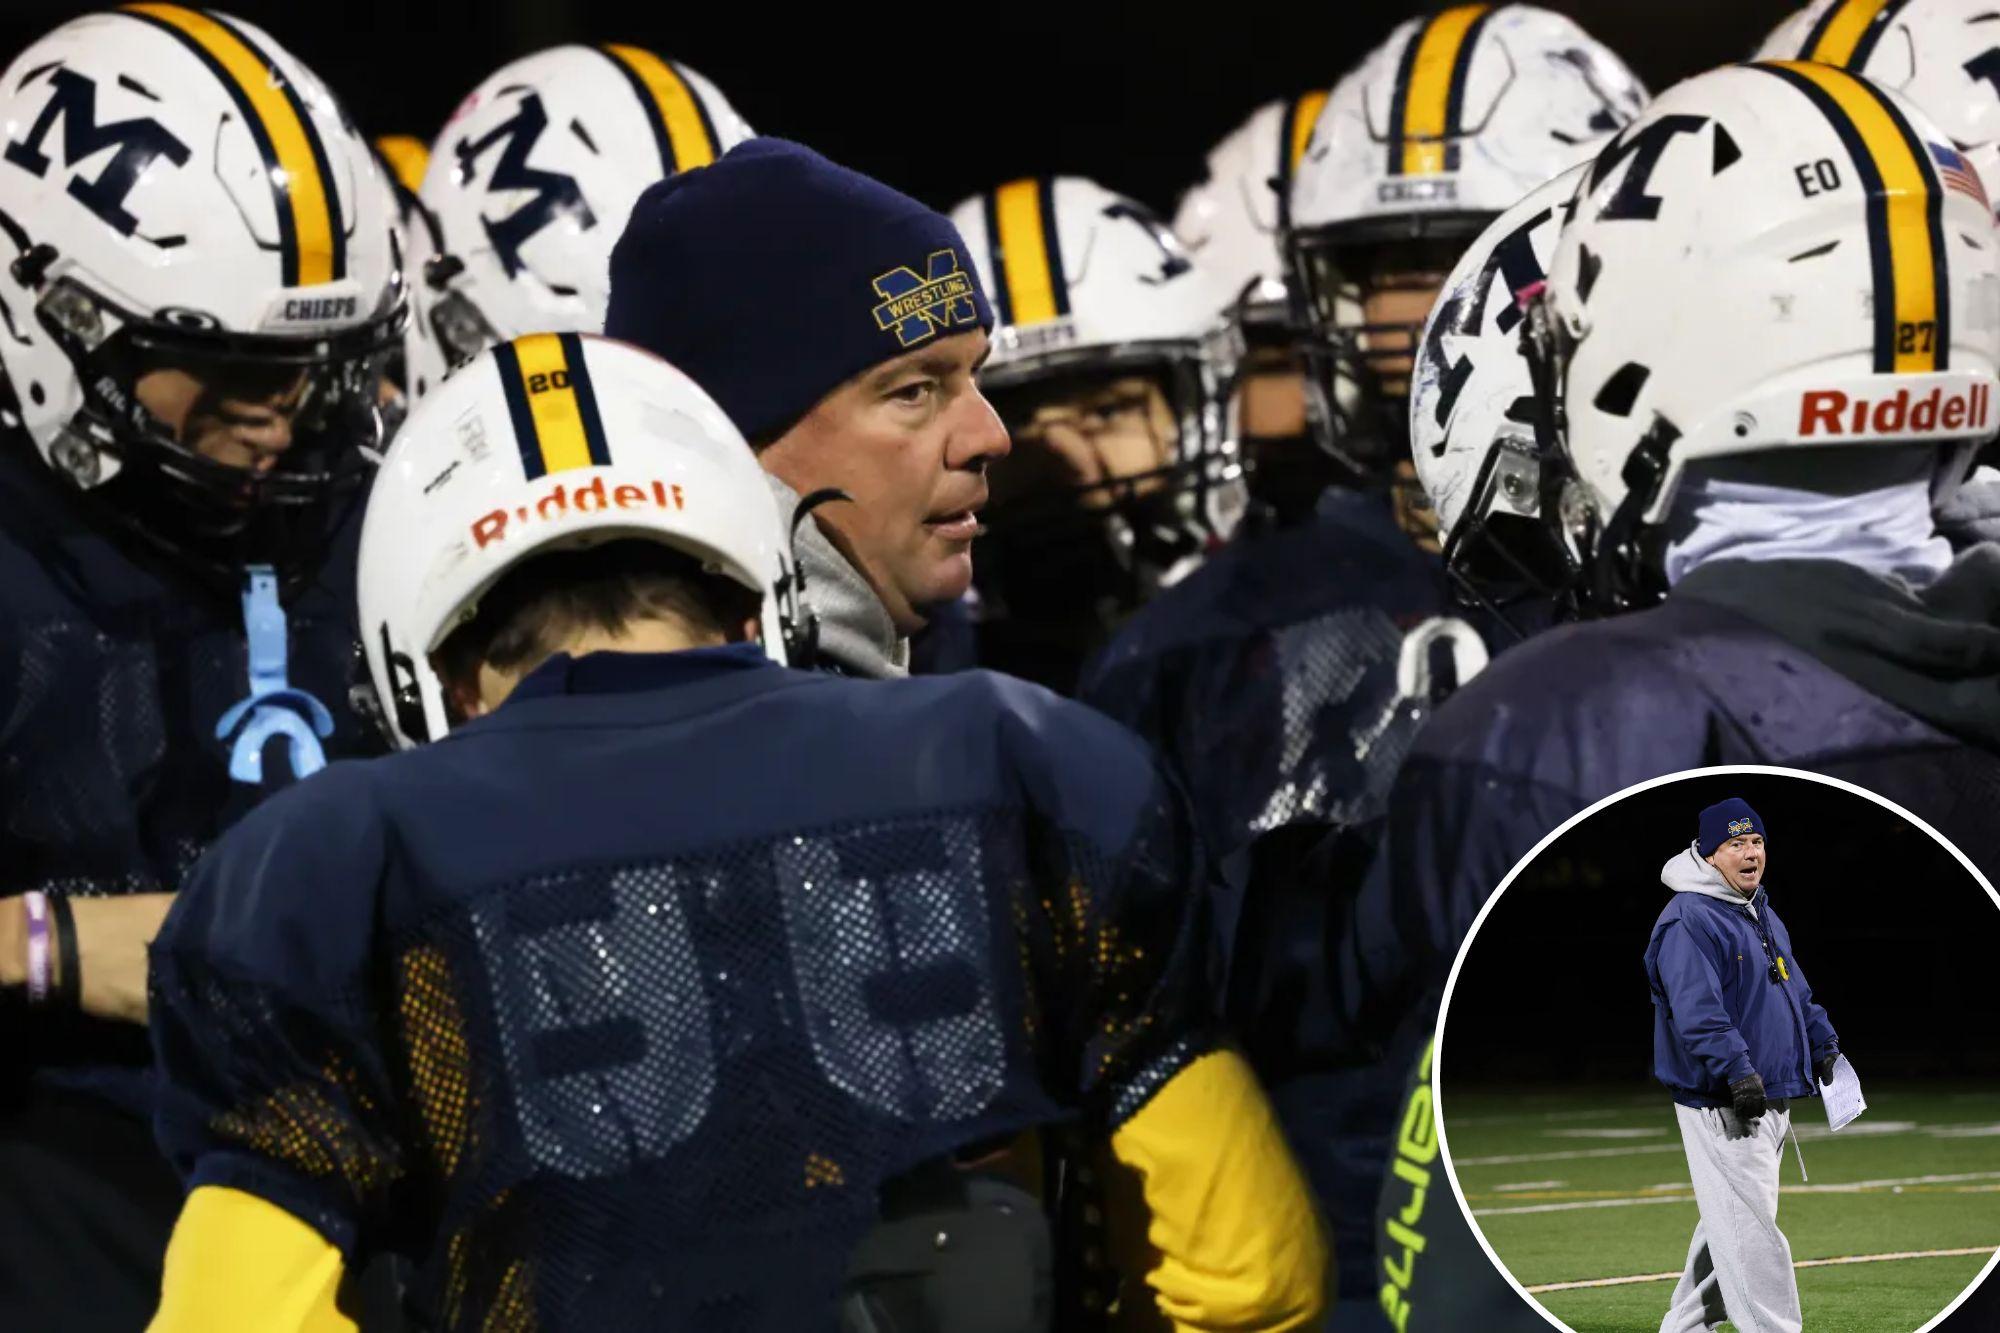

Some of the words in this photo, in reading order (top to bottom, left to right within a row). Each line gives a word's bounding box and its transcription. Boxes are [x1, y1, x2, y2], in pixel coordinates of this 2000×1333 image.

[4, 67, 192, 238] M
[455, 92, 597, 281] M
[1794, 158, 1841, 198] EO
[286, 297, 356, 320] CHIEFS
[888, 280, 966, 318] WRESTLING
[1897, 321, 1935, 354] 27
[528, 370, 573, 394] 20
[1799, 384, 1989, 436] Riddell
[471, 476, 685, 548] Riddell
